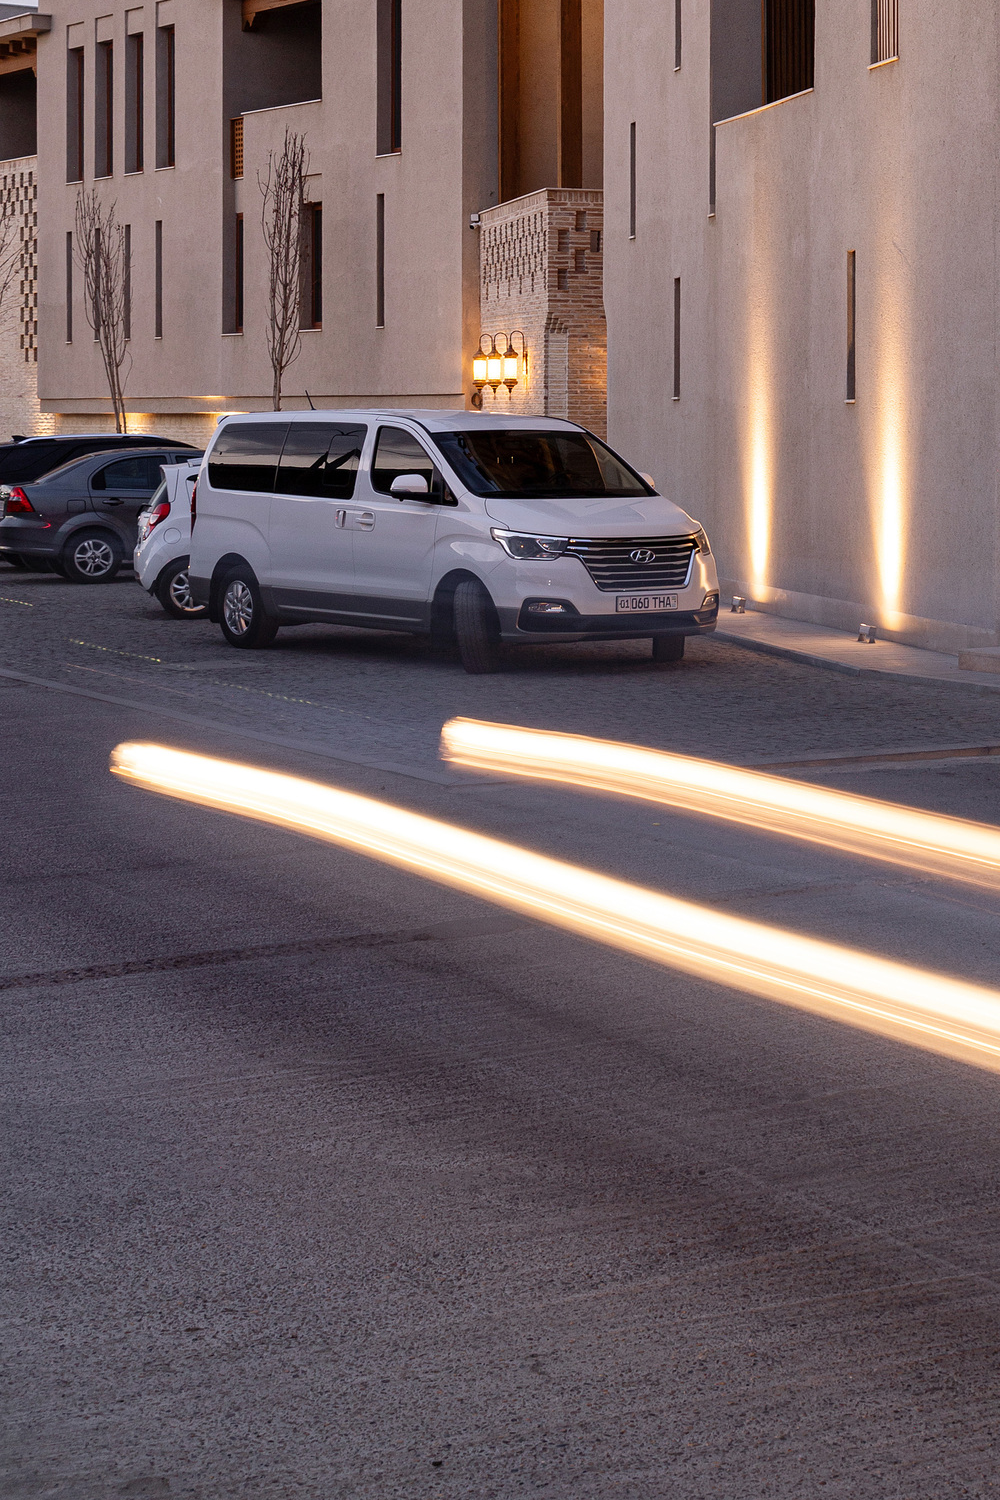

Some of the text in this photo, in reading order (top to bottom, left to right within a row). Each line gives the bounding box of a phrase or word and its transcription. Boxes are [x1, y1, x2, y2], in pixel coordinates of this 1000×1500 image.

[620, 596, 672, 610] 01 060 THA
